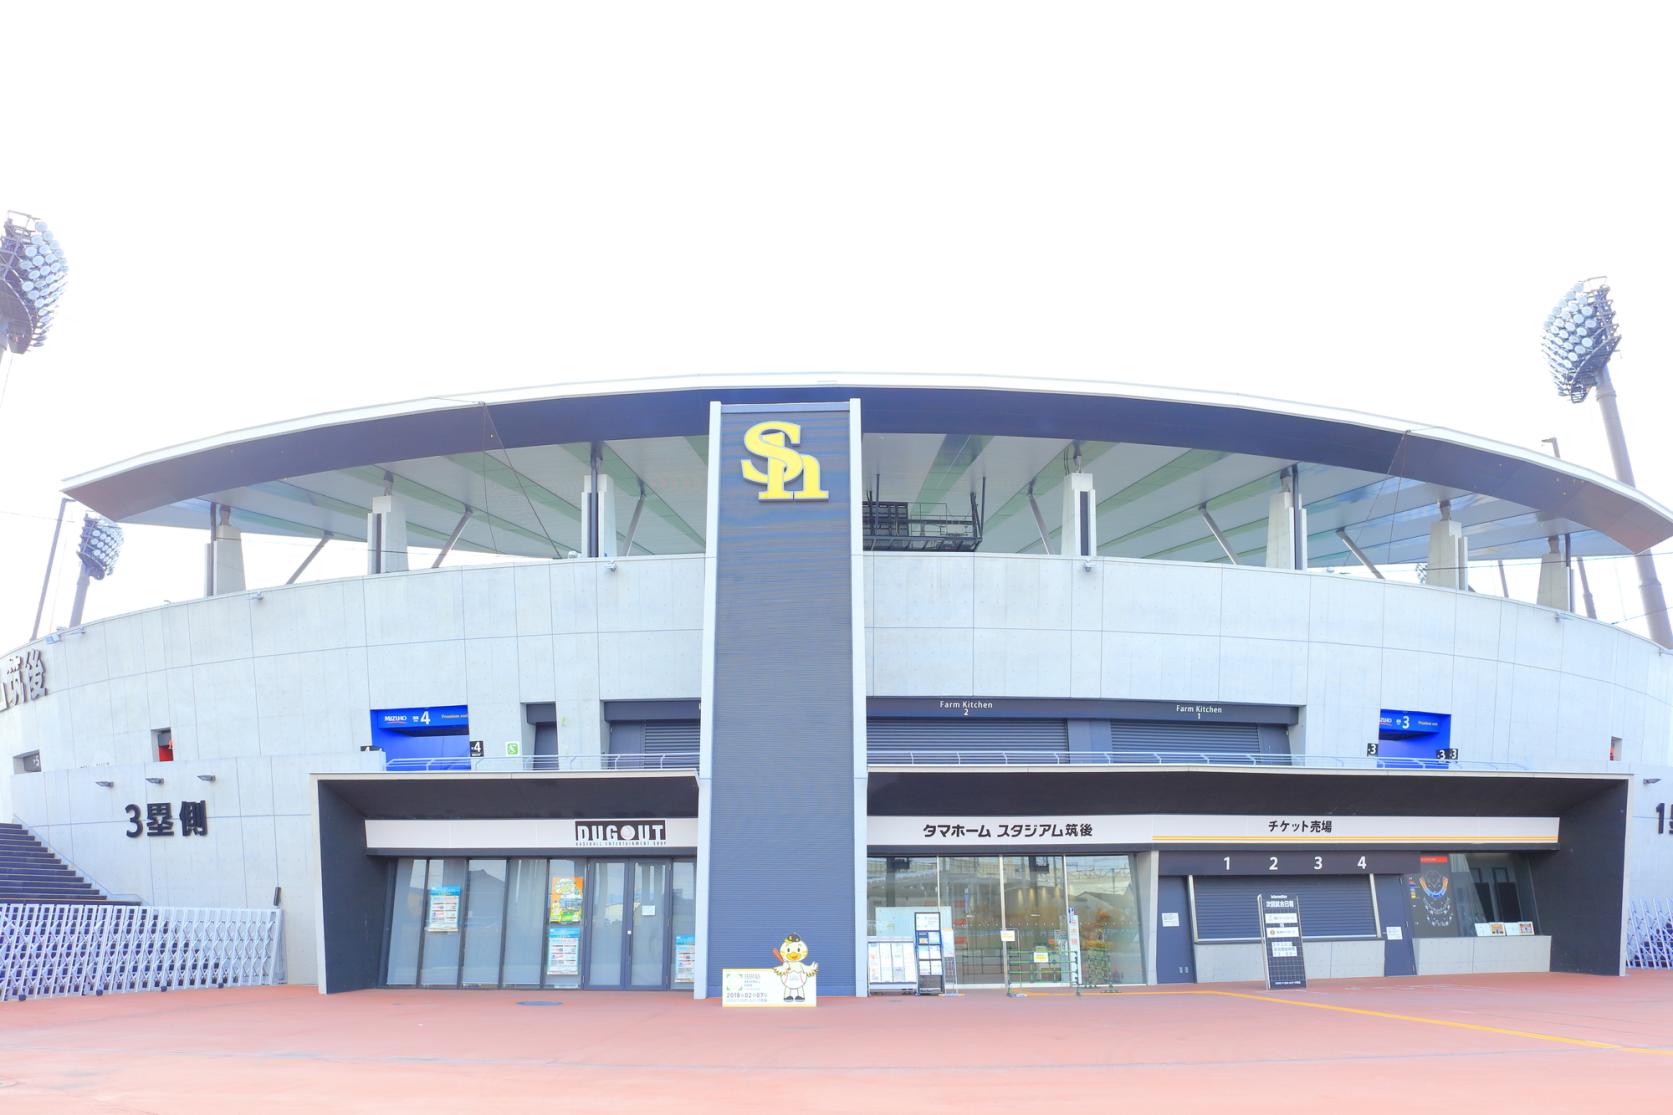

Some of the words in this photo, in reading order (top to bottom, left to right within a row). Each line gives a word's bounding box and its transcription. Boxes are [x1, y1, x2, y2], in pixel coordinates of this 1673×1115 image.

[939, 700, 960, 710] Farm
[962, 700, 993, 710] Kitchen
[1176, 705, 1194, 714] Farm
[1196, 705, 1223, 715] Kitchen
[421, 711, 431, 724] 4
[1403, 716, 1410, 729] 3
[473, 741, 481, 752] 4
[1370, 744, 1376, 754] 3
[1440, 750, 1445, 760] 3
[1452, 749, 1457, 759] 3
[125, 800, 208, 838] 3塁側
[1656, 802, 1673, 835] 1
[578, 825, 663, 841] DUGOUT
[923, 824, 992, 838] タマホーム
[997, 823, 1093, 838] スタジアム筑後
[1268, 820, 1333, 833] チケット売場
[1223, 856, 1231, 870] 1
[1269, 856, 1279, 870] 2
[1313, 856, 1323, 870] 3
[1357, 856, 1367, 869] 4
